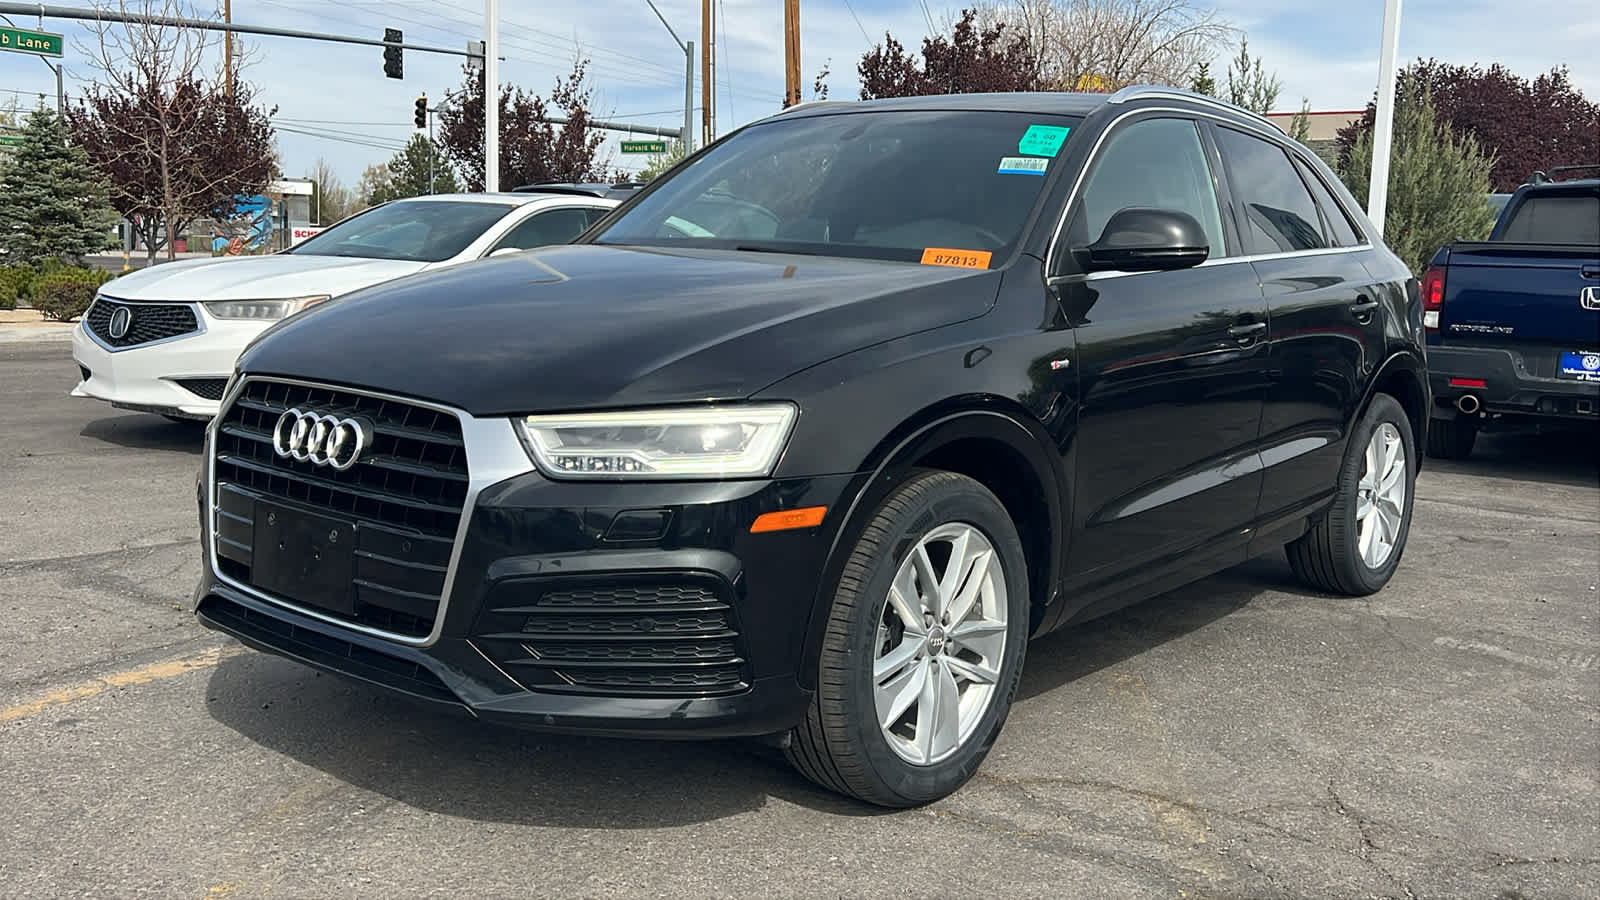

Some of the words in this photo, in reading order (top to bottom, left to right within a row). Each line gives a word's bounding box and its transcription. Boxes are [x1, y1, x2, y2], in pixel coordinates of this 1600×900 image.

[17, 35, 50, 50] Lane
[650, 144, 663, 152] Way
[935, 255, 977, 267] 87813
